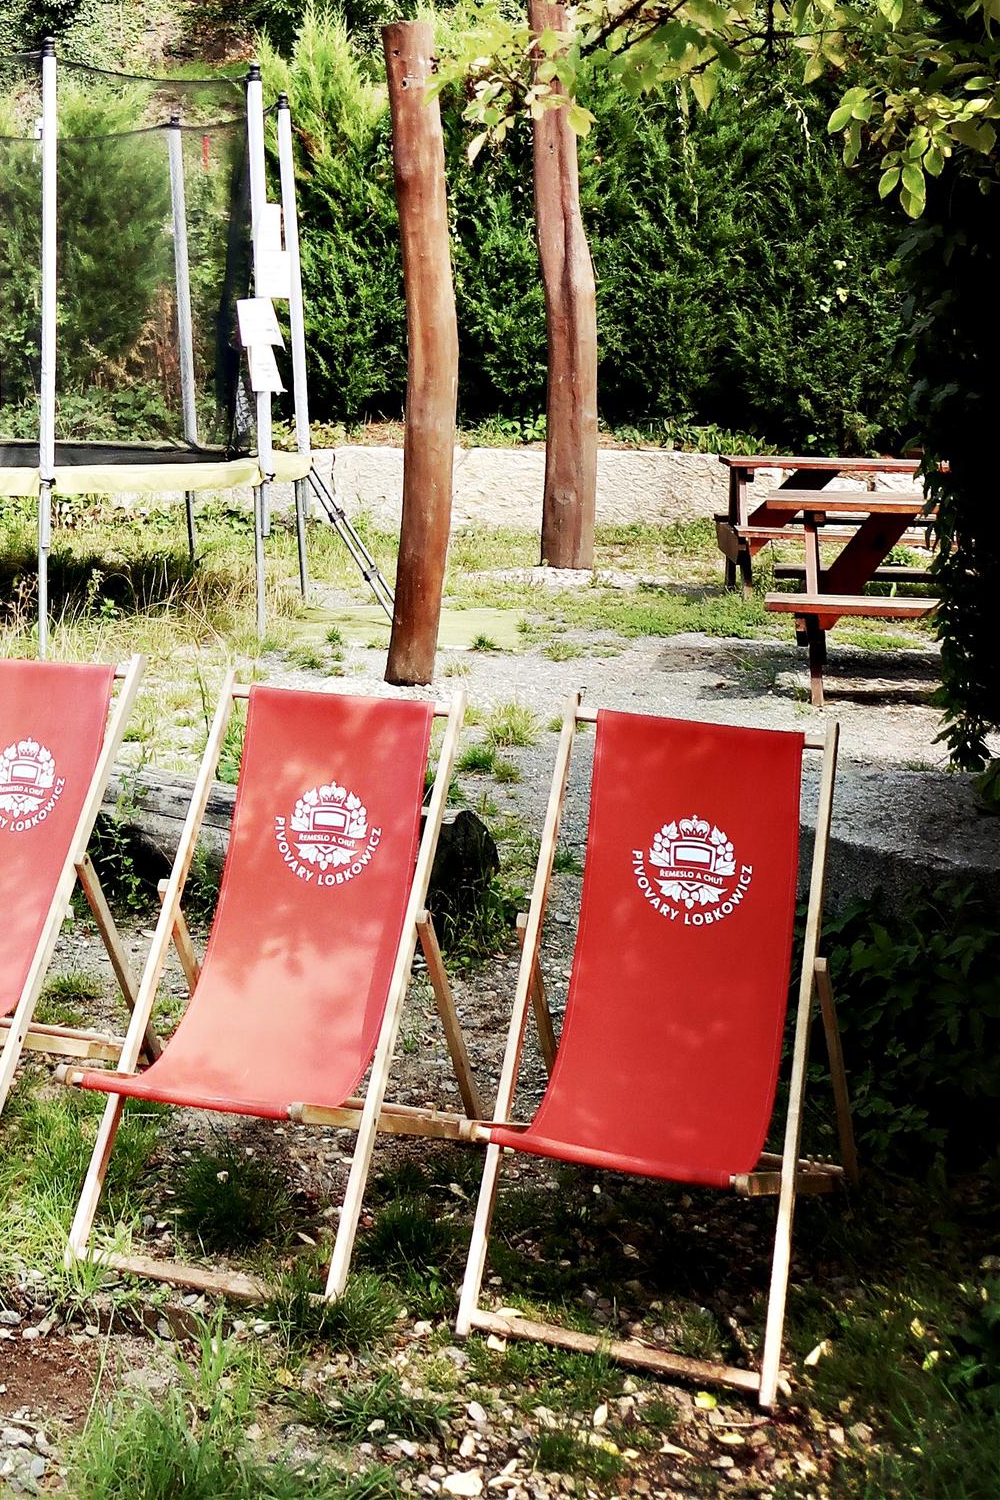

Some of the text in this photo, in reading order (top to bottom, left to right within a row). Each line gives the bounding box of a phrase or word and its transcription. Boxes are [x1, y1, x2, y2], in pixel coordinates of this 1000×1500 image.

[9, 777, 66, 832] LOBKOWICZ
[275, 816, 381, 886] PIVOVARY LOBKOWICZ
[695, 871, 702, 880] A
[632, 850, 753, 926] PIVOVARY LOBKOWICZ
